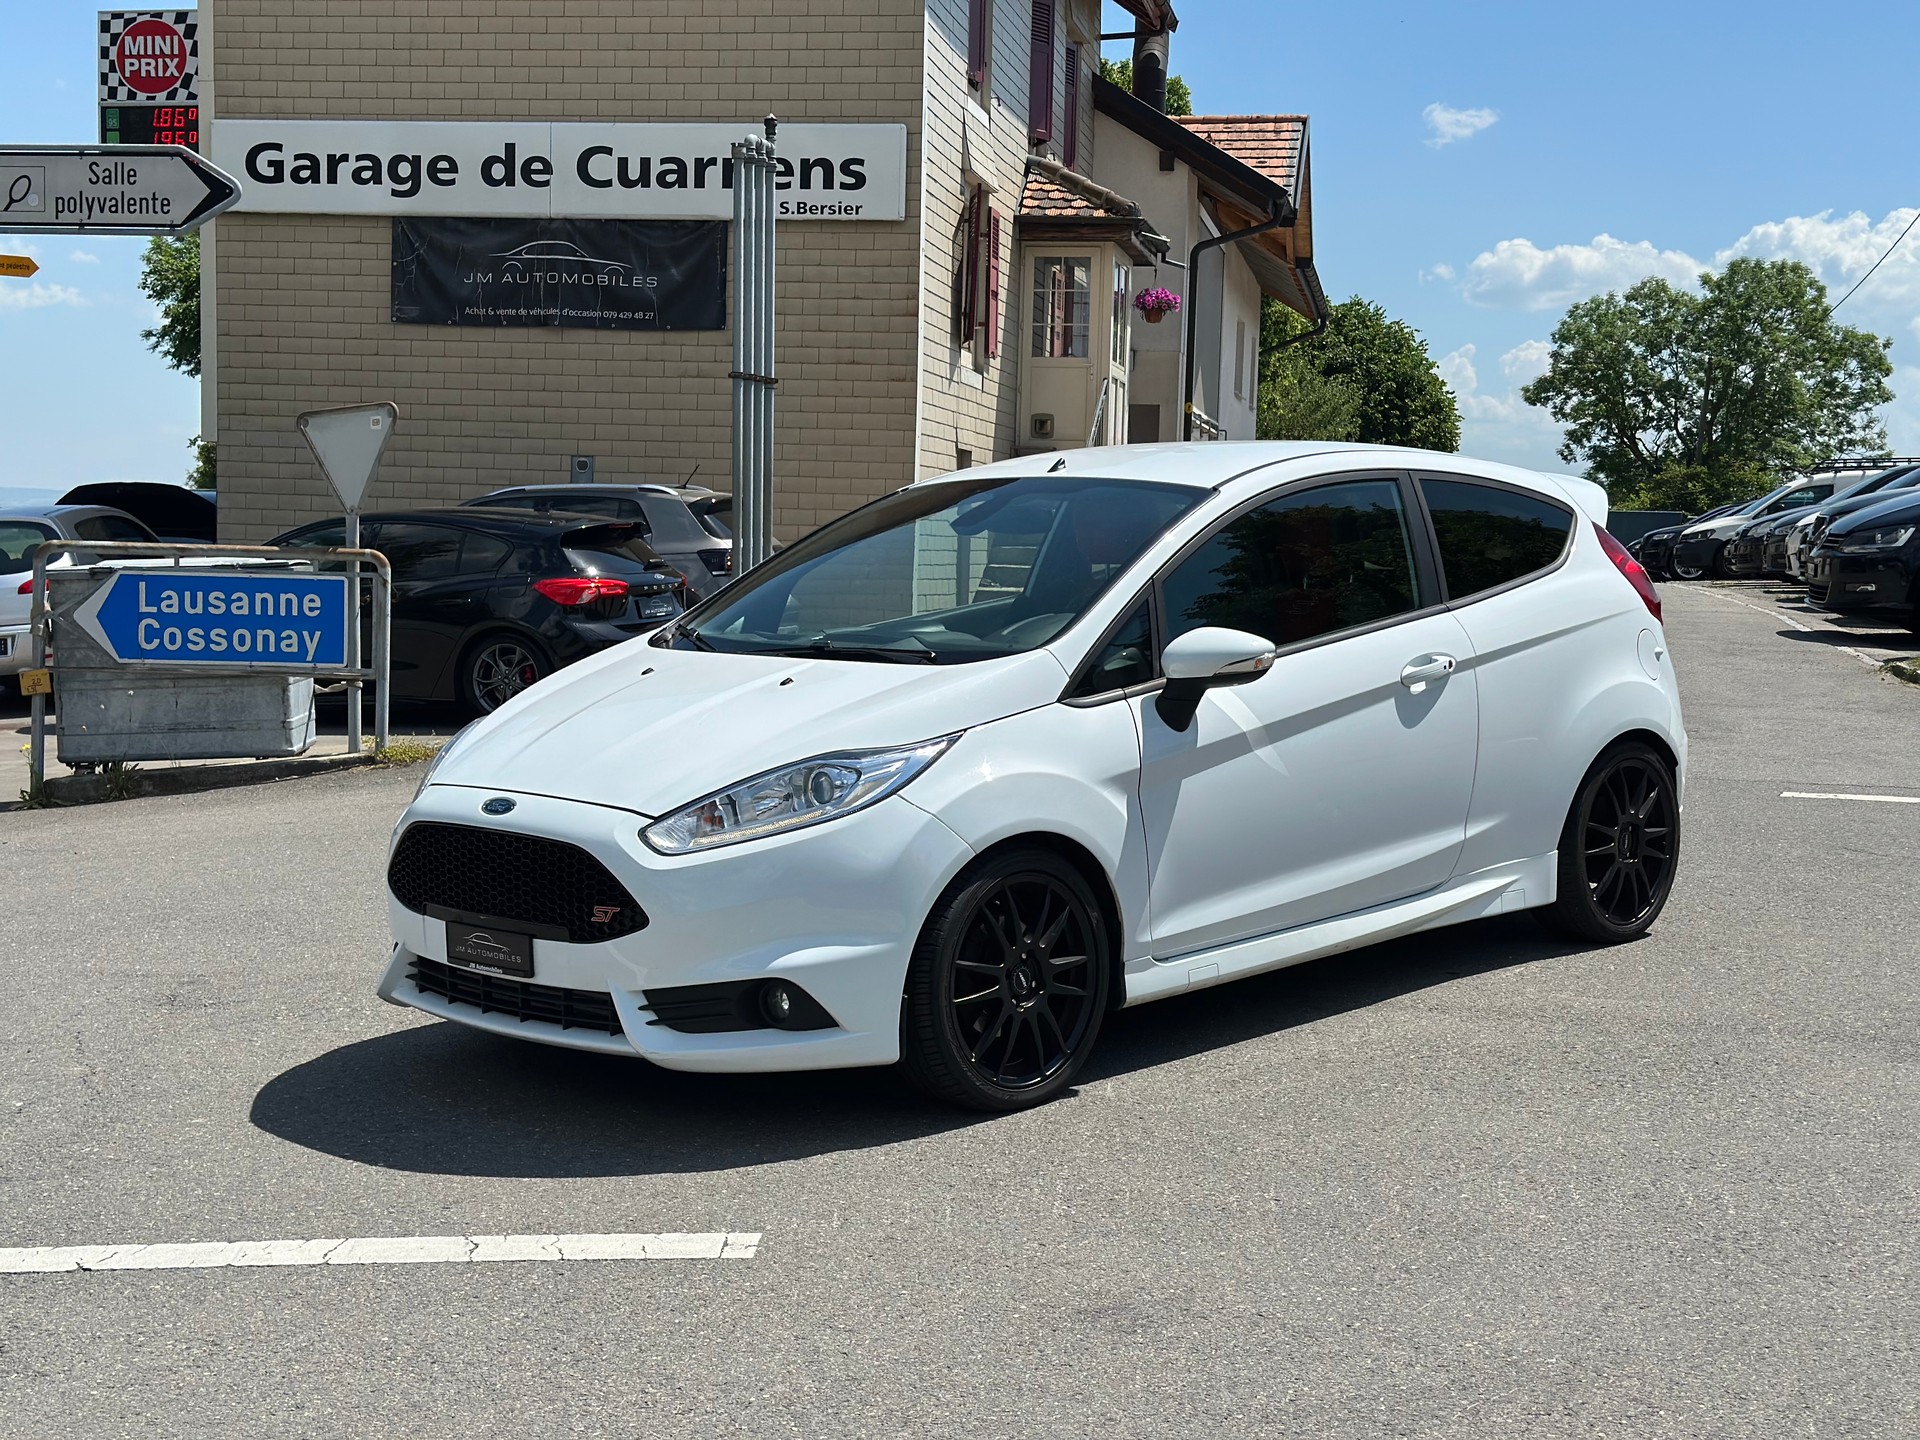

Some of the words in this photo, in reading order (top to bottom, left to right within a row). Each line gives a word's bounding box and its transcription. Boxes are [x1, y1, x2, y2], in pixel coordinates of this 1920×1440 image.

[124, 35, 179, 56] MINI
[124, 58, 180, 78] PRIX
[88, 161, 138, 186] Salle
[244, 142, 459, 198] Garage
[480, 142, 554, 188] de
[54, 190, 171, 220] polyvalente
[779, 201, 863, 215] S.Bersier
[463, 272, 492, 283] JM
[501, 272, 658, 288] AUTOMOBILES
[464, 306, 487, 316] Achat
[487, 307, 495, 315] &
[496, 308, 517, 316] vente
[518, 307, 528, 316] de
[529, 307, 560, 316] véhicules
[562, 308, 602, 318] d'occasion
[603, 310, 618, 319] 079
[618, 311, 633, 320] 429
[633, 311, 643, 320] 48
[644, 312, 654, 320] 27
[138, 581, 322, 617] Lausanne
[138, 618, 321, 661] Cossonay
[590, 905, 621, 923] ST
[467, 947, 522, 963] AUTOMOBILES
